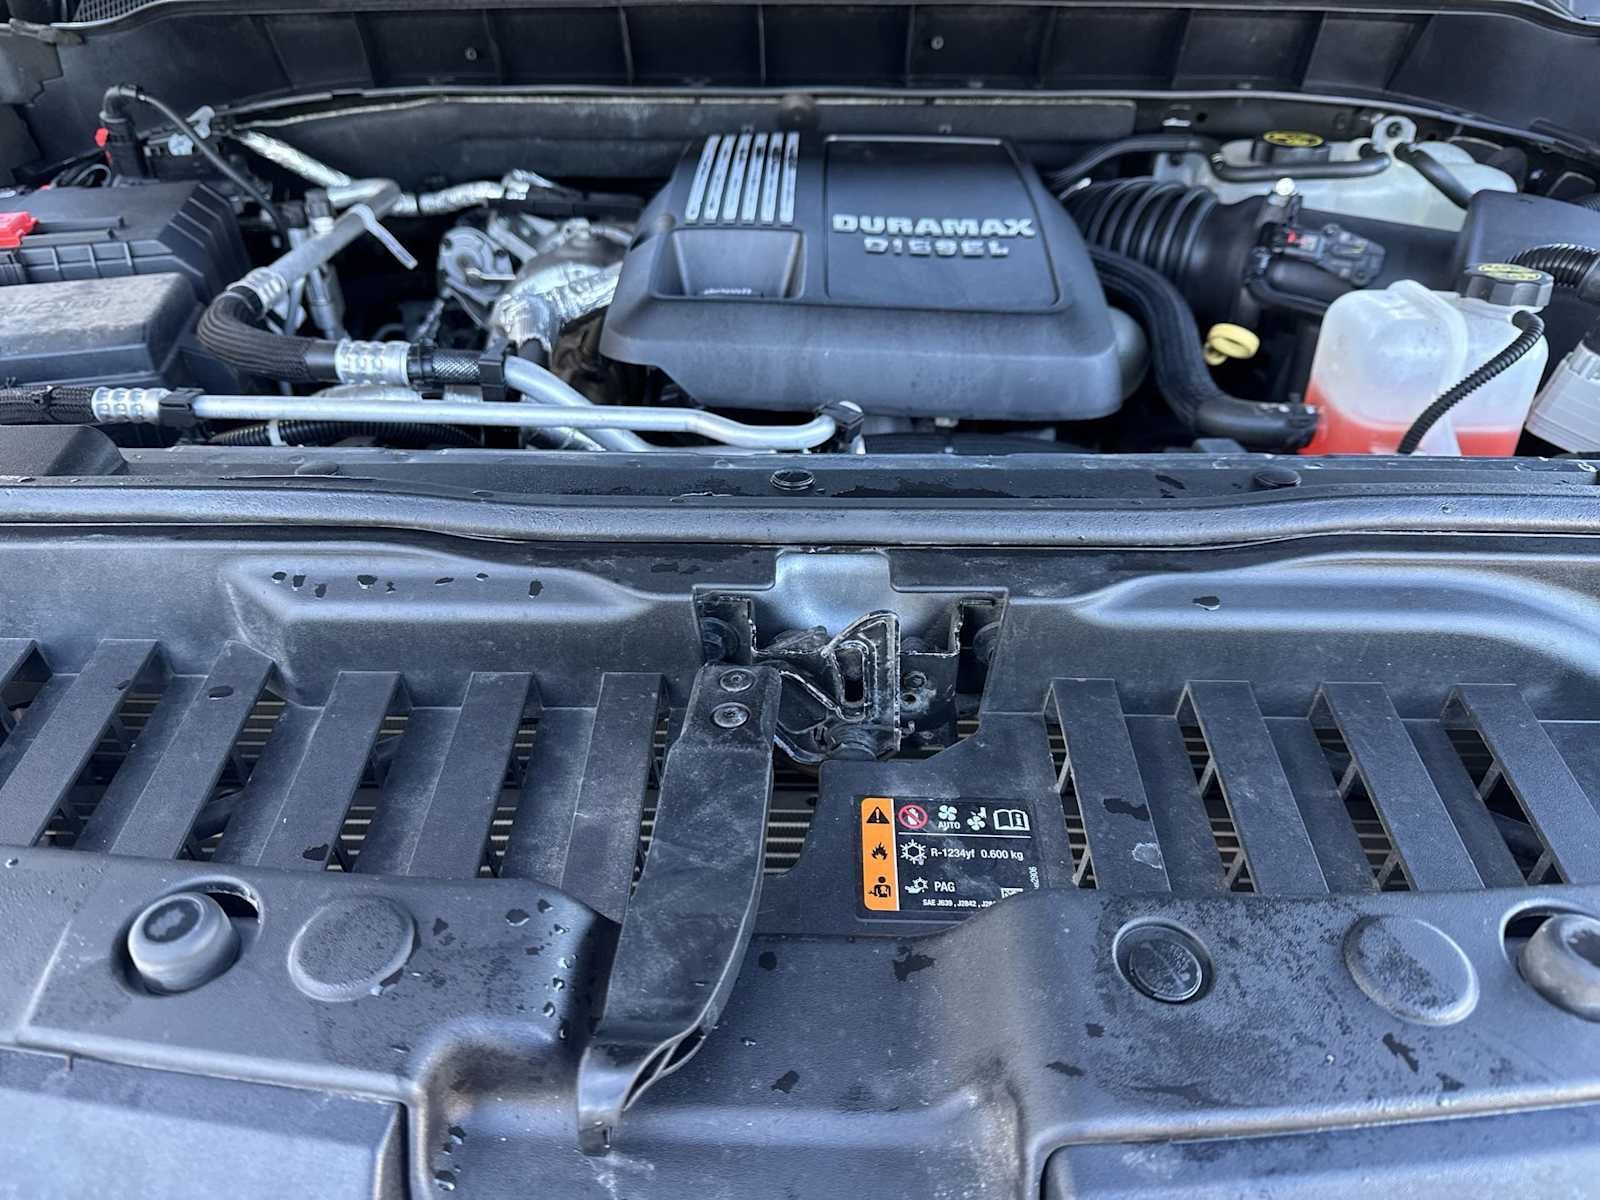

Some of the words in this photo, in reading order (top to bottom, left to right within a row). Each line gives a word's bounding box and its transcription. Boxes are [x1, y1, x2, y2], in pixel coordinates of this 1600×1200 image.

[832, 213, 1036, 237] DURAMAX
[863, 236, 1009, 256] DIESEL
[938, 821, 961, 830] AUTO
[930, 848, 975, 860] R-1234yf
[980, 849, 1009, 859] 0.600
[1010, 849, 1024, 862] kg
[934, 881, 956, 893] PAG
[922, 898, 936, 906] SAE
